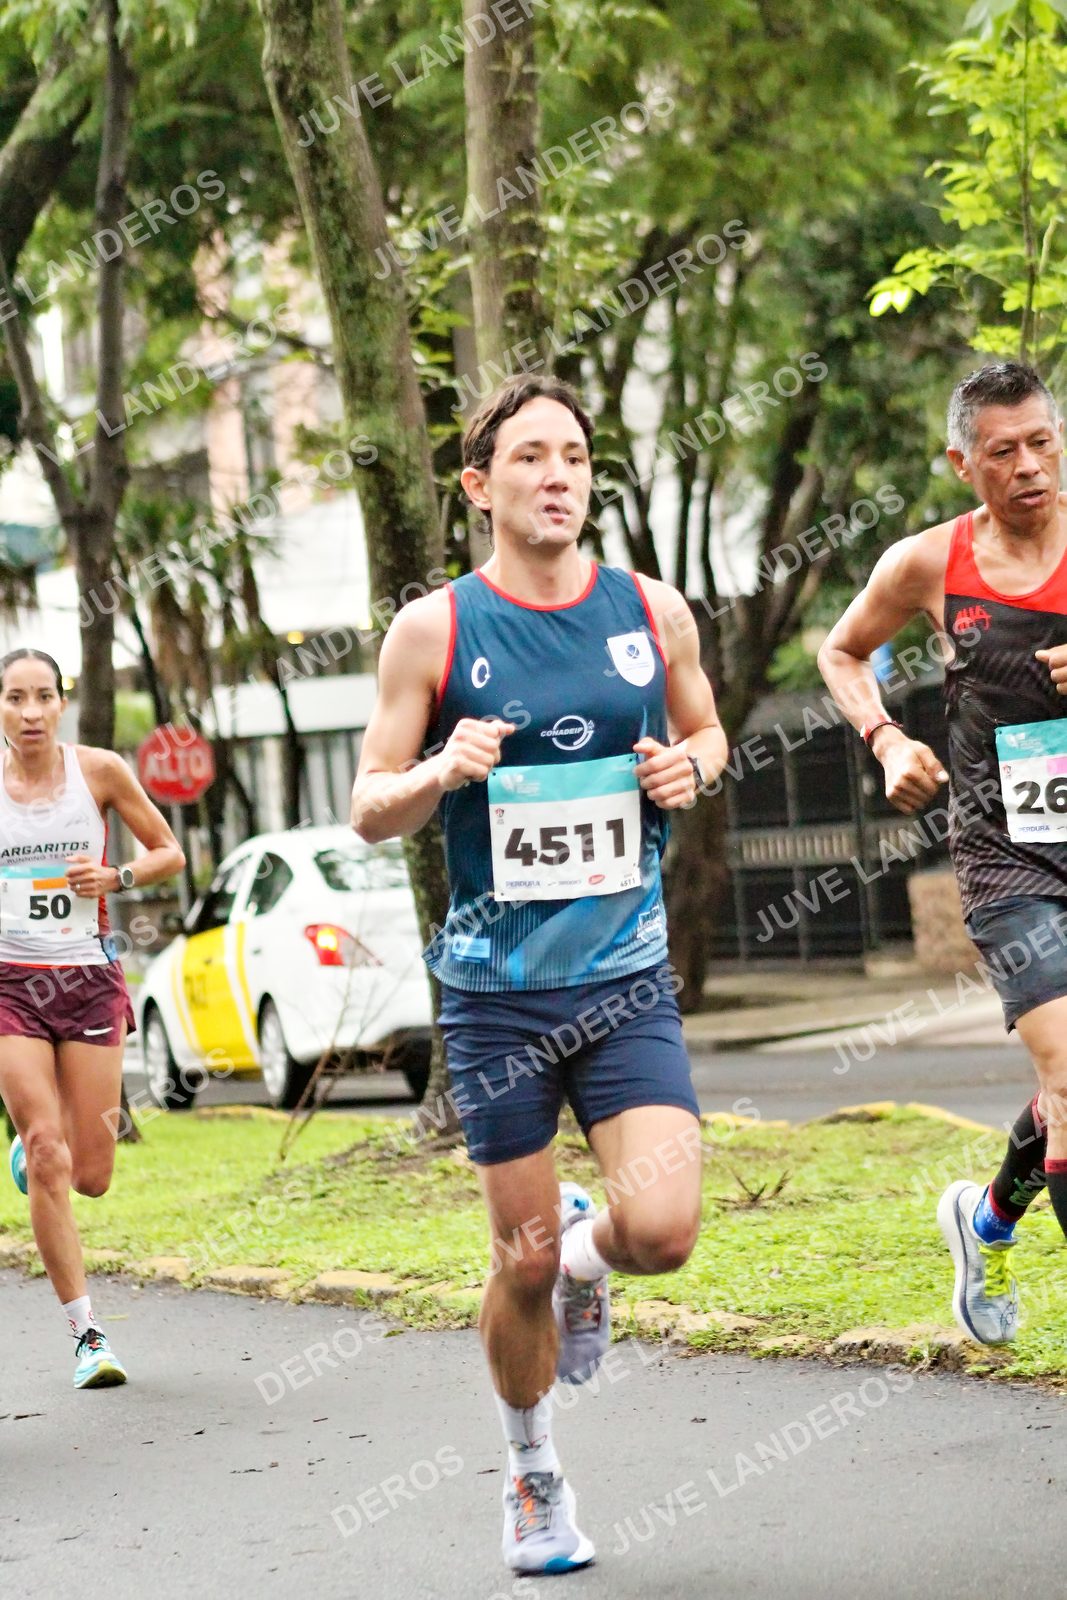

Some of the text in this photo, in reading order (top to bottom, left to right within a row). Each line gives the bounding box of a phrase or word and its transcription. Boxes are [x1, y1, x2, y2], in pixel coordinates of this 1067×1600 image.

[541, 727, 583, 737] CONADEIP
[144, 747, 211, 781] ALTO
[1012, 777, 1067, 815] 26
[504, 818, 626, 867] 4511
[7, 853, 46, 864] RUNNING
[29, 894, 71, 920] 50
